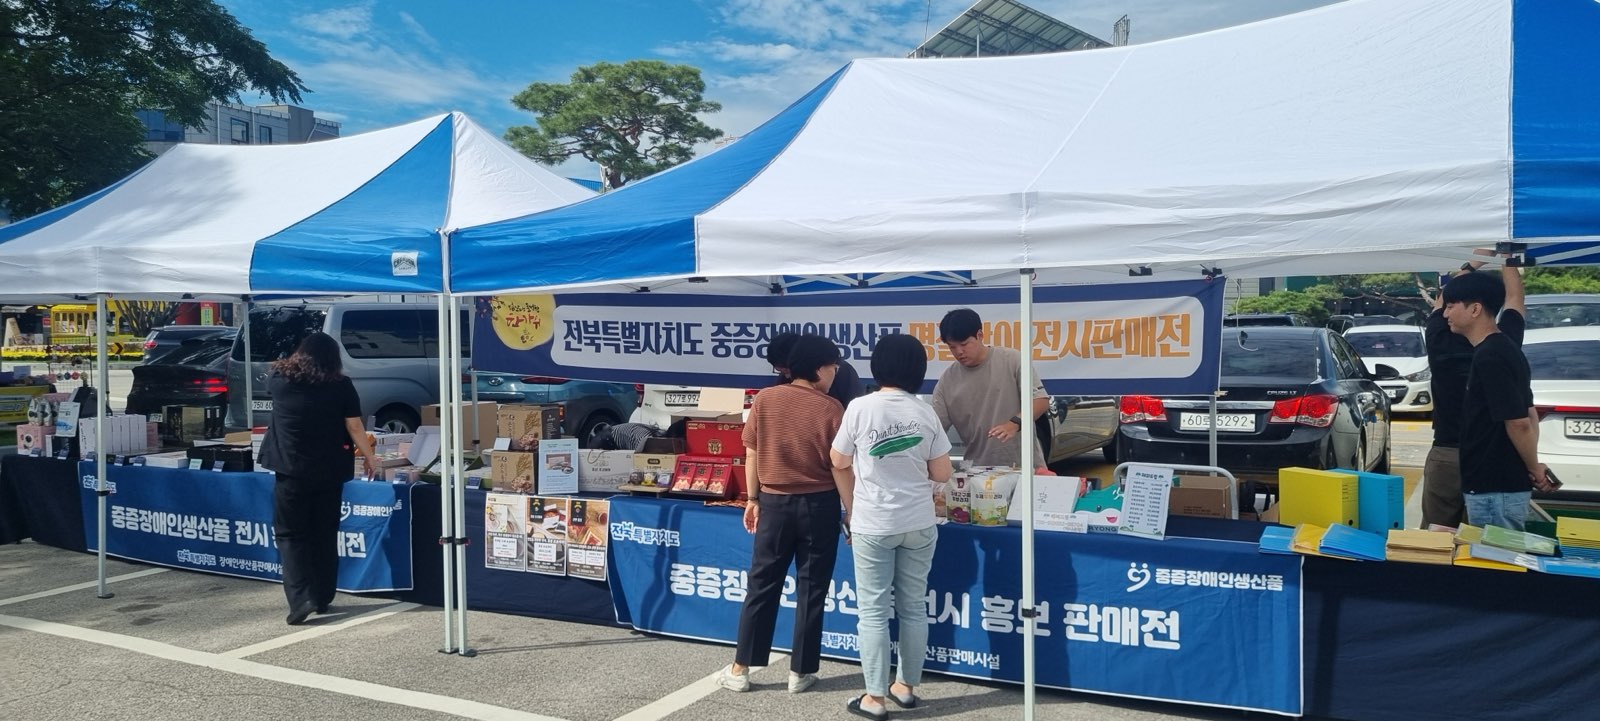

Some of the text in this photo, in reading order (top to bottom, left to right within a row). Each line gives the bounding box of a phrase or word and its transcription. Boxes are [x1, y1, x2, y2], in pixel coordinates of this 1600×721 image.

[562, 319, 704, 356] 전북특별자치도
[1032, 313, 1191, 361] 전시판매전
[111, 505, 231, 543] 중증장애인생산품
[235, 520, 270, 548] 전시
[610, 521, 681, 547] 전북특별자치도
[1155, 568, 1284, 592] 중증장애인생산품
[1063, 603, 1182, 650] 판매전
